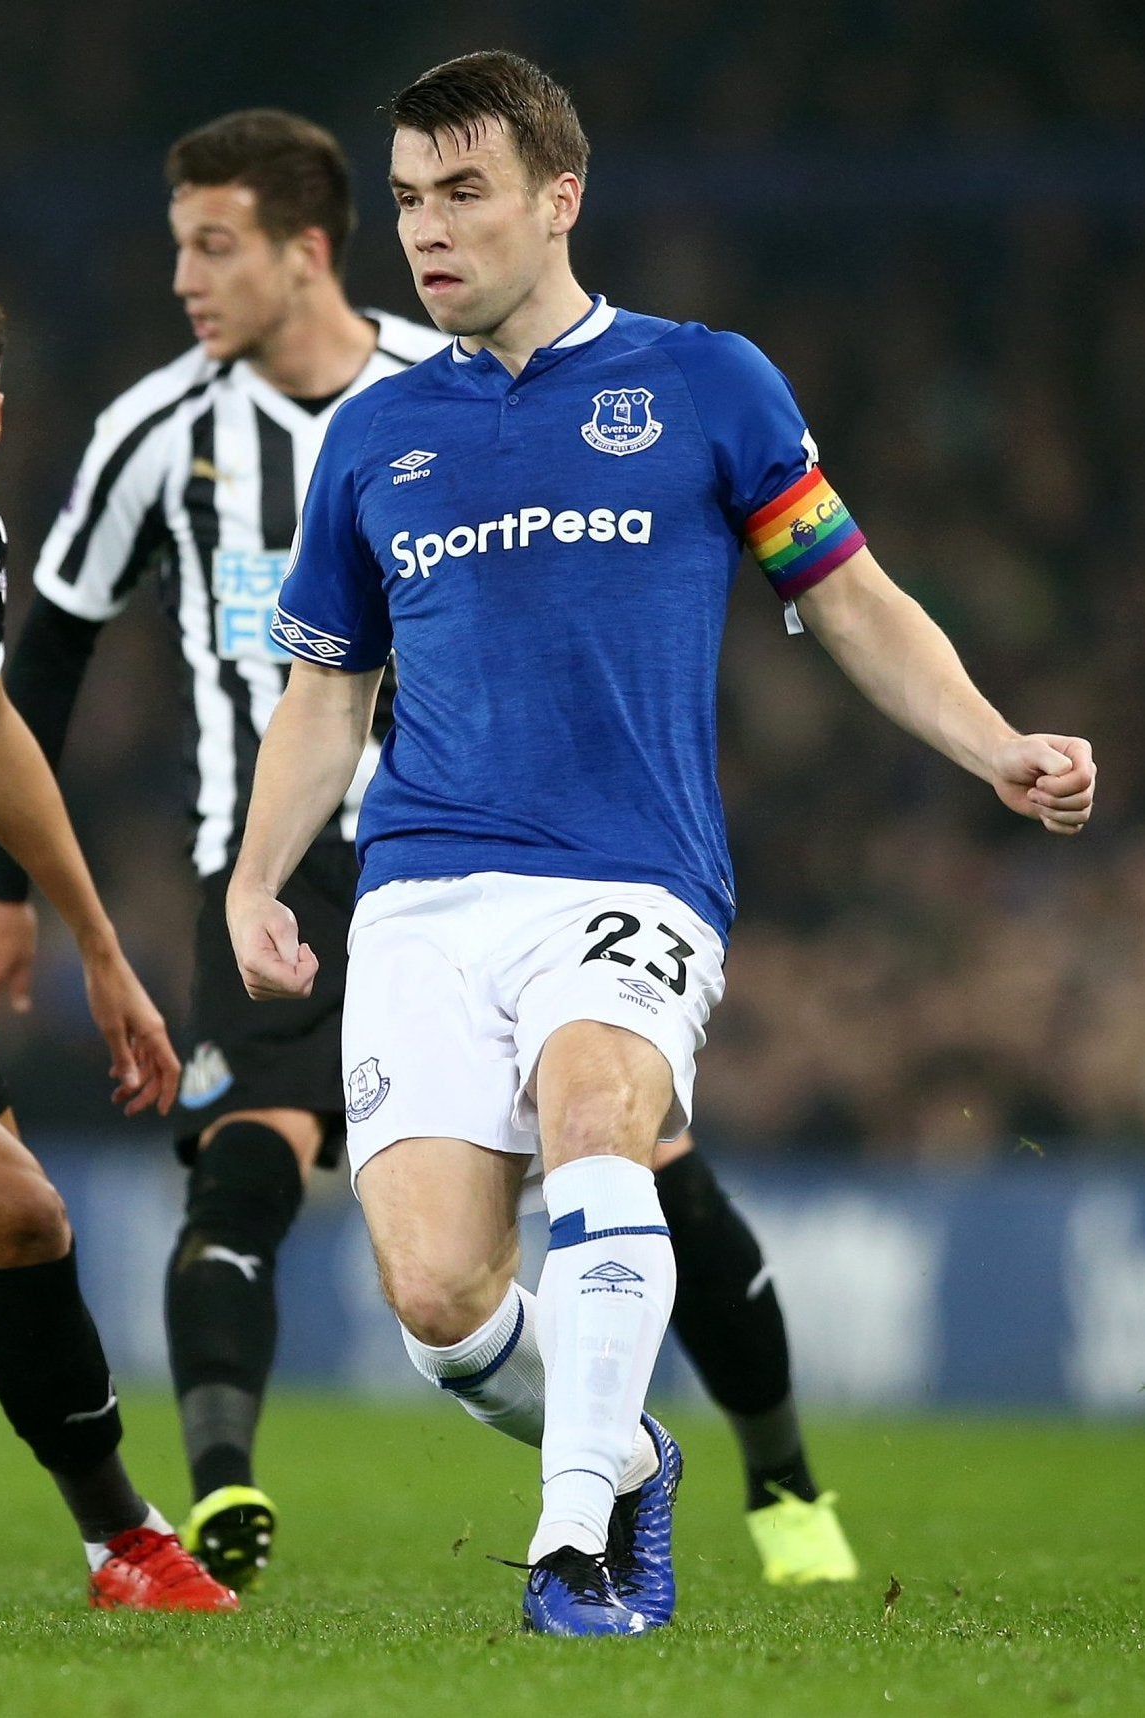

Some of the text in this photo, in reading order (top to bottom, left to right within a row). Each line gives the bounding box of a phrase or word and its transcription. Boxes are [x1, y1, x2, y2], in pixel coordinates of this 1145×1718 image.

[600, 424, 642, 434] Everton
[392, 469, 431, 485] umbro
[391, 506, 652, 579] SportPesa
[579, 911, 695, 996] 23
[618, 992, 658, 1015] umbro
[581, 1283, 643, 1298] umbro
